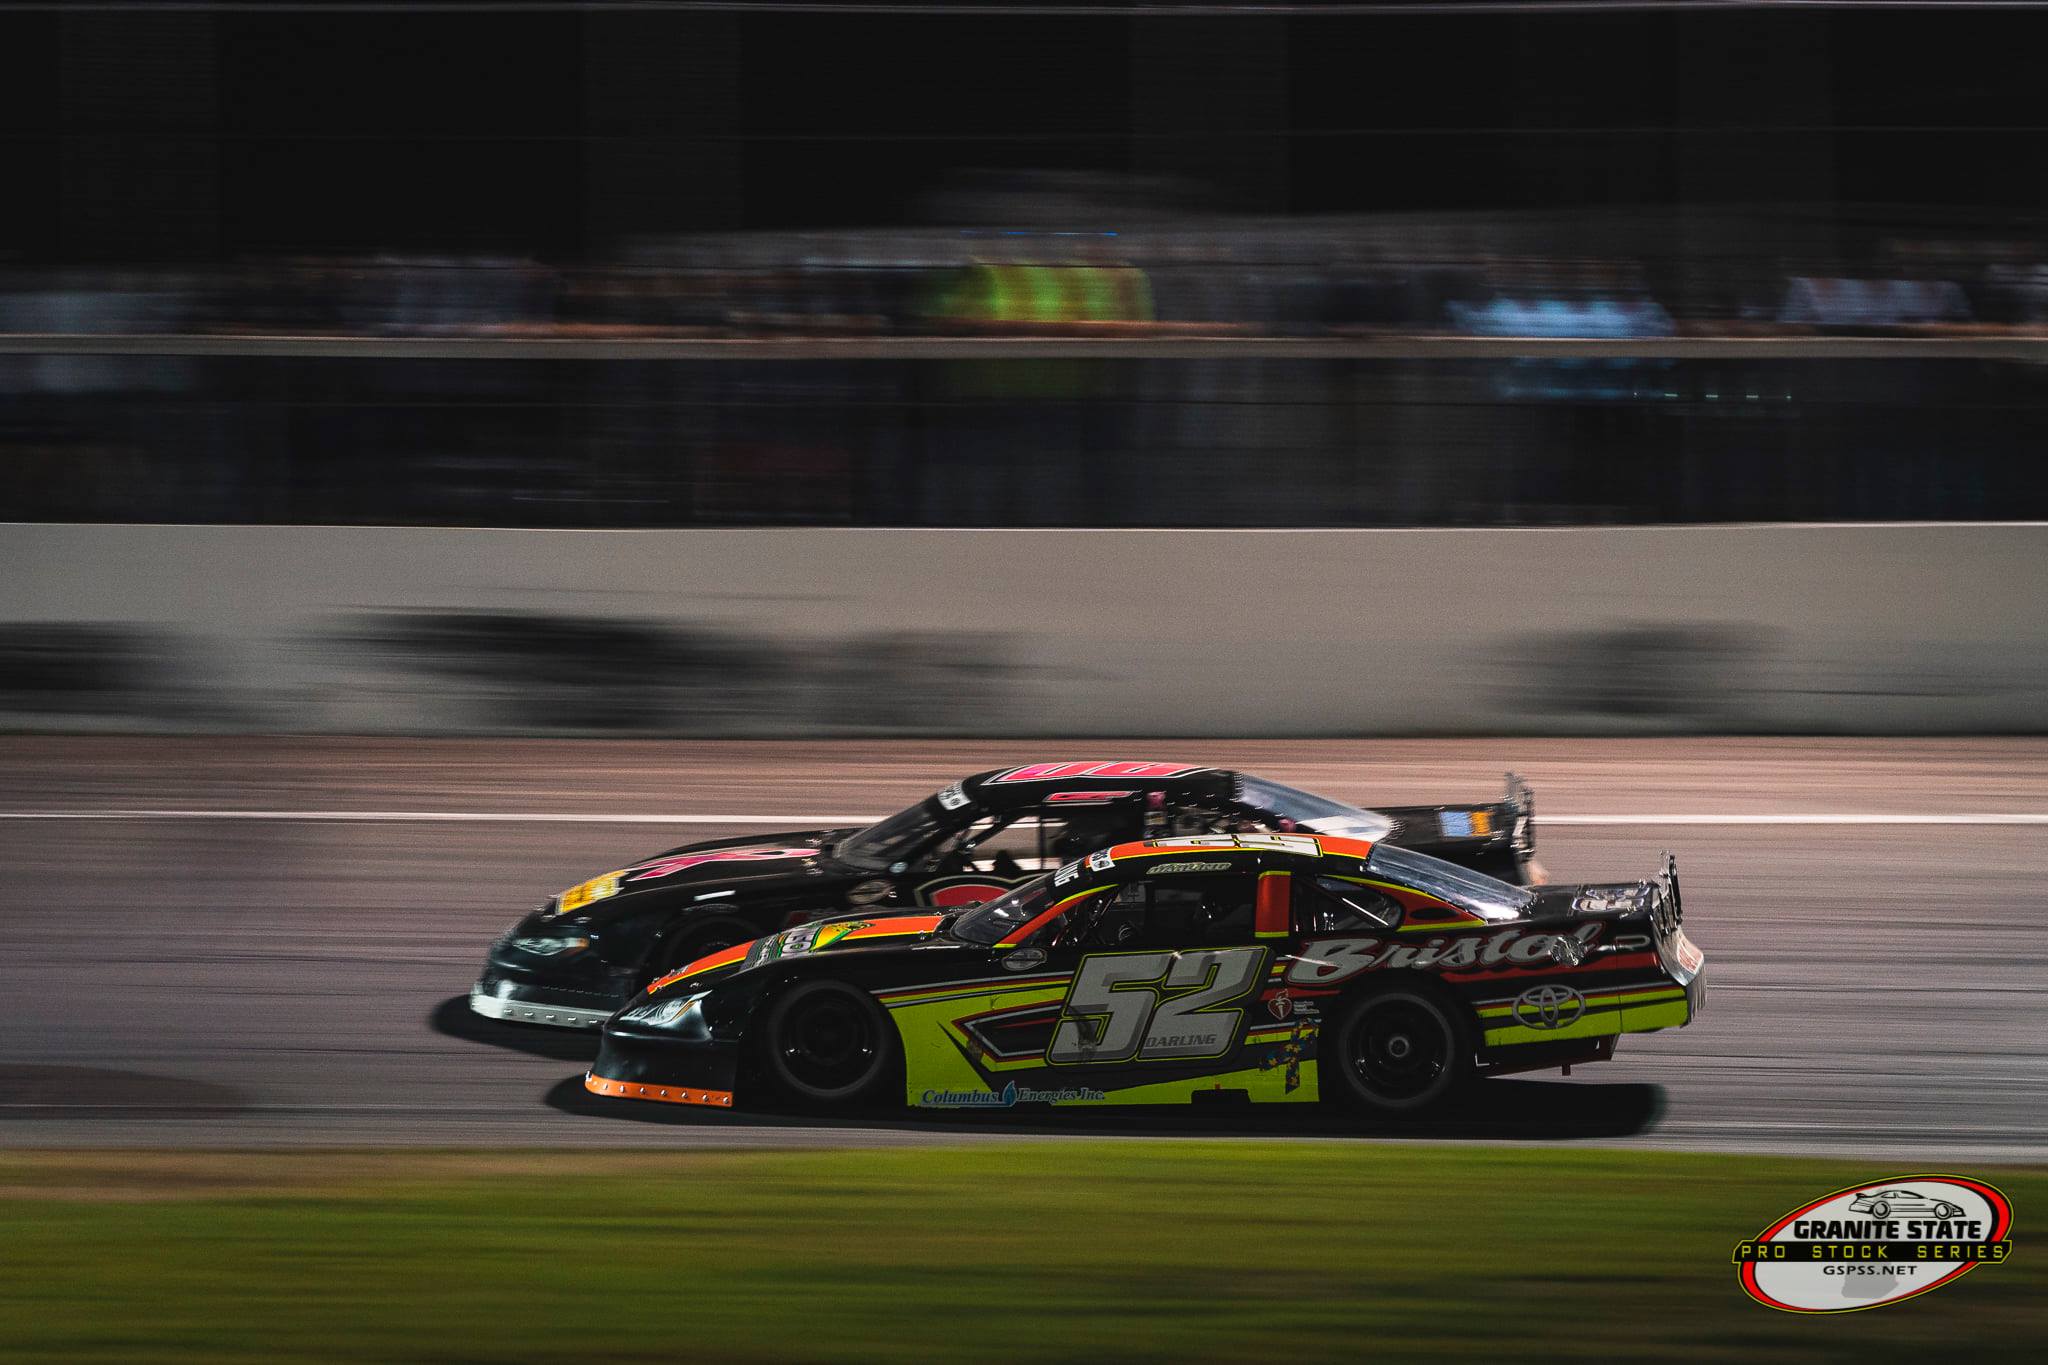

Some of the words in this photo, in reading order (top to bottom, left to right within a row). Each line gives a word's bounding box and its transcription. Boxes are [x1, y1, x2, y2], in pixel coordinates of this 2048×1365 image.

[1286, 920, 1605, 985] Bristol
[1047, 947, 1268, 1064] 52
[1145, 1034, 1217, 1048] DARLING
[921, 1089, 999, 1104] Columbus
[1018, 1088, 1080, 1103] Energies
[1080, 1087, 1105, 1101] Inc.
